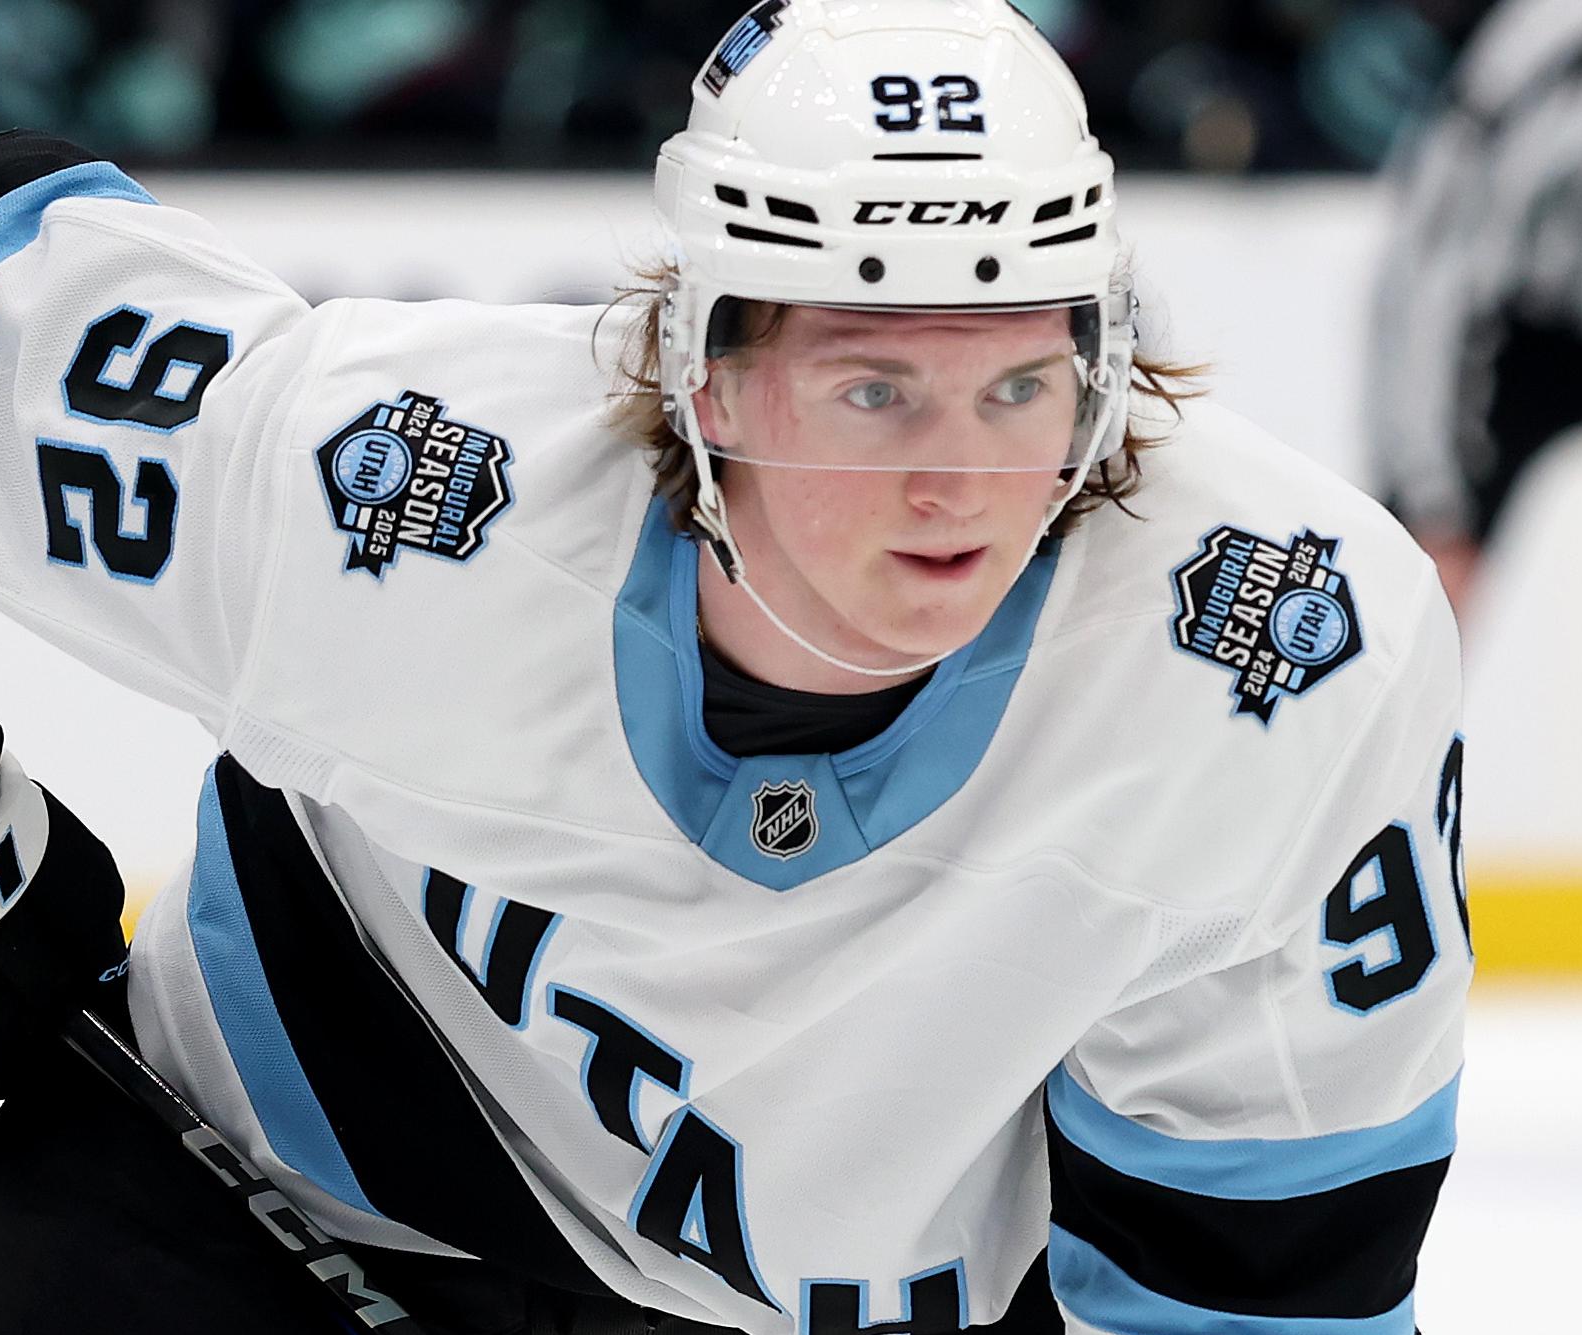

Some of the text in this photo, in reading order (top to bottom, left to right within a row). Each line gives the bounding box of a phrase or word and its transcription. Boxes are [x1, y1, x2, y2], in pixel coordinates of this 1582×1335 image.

[871, 75, 985, 133] 92
[852, 200, 1011, 225] CCM
[35, 303, 234, 585] 92
[404, 402, 435, 438] 2024
[351, 439, 392, 495] UTAH
[397, 421, 466, 546] SEASON
[432, 431, 491, 548] INAUGURAL
[369, 508, 397, 557] 2025
[1287, 541, 1318, 585] 2025
[1191, 538, 1257, 655] INAUGURAL
[1215, 541, 1289, 667] SEASON
[1288, 599, 1331, 655] UTAH
[1243, 649, 1277, 697] 2024
[766, 800, 805, 844] NHL
[1319, 729, 1473, 1017] 9
[182, 1126, 410, 1329] CCM
